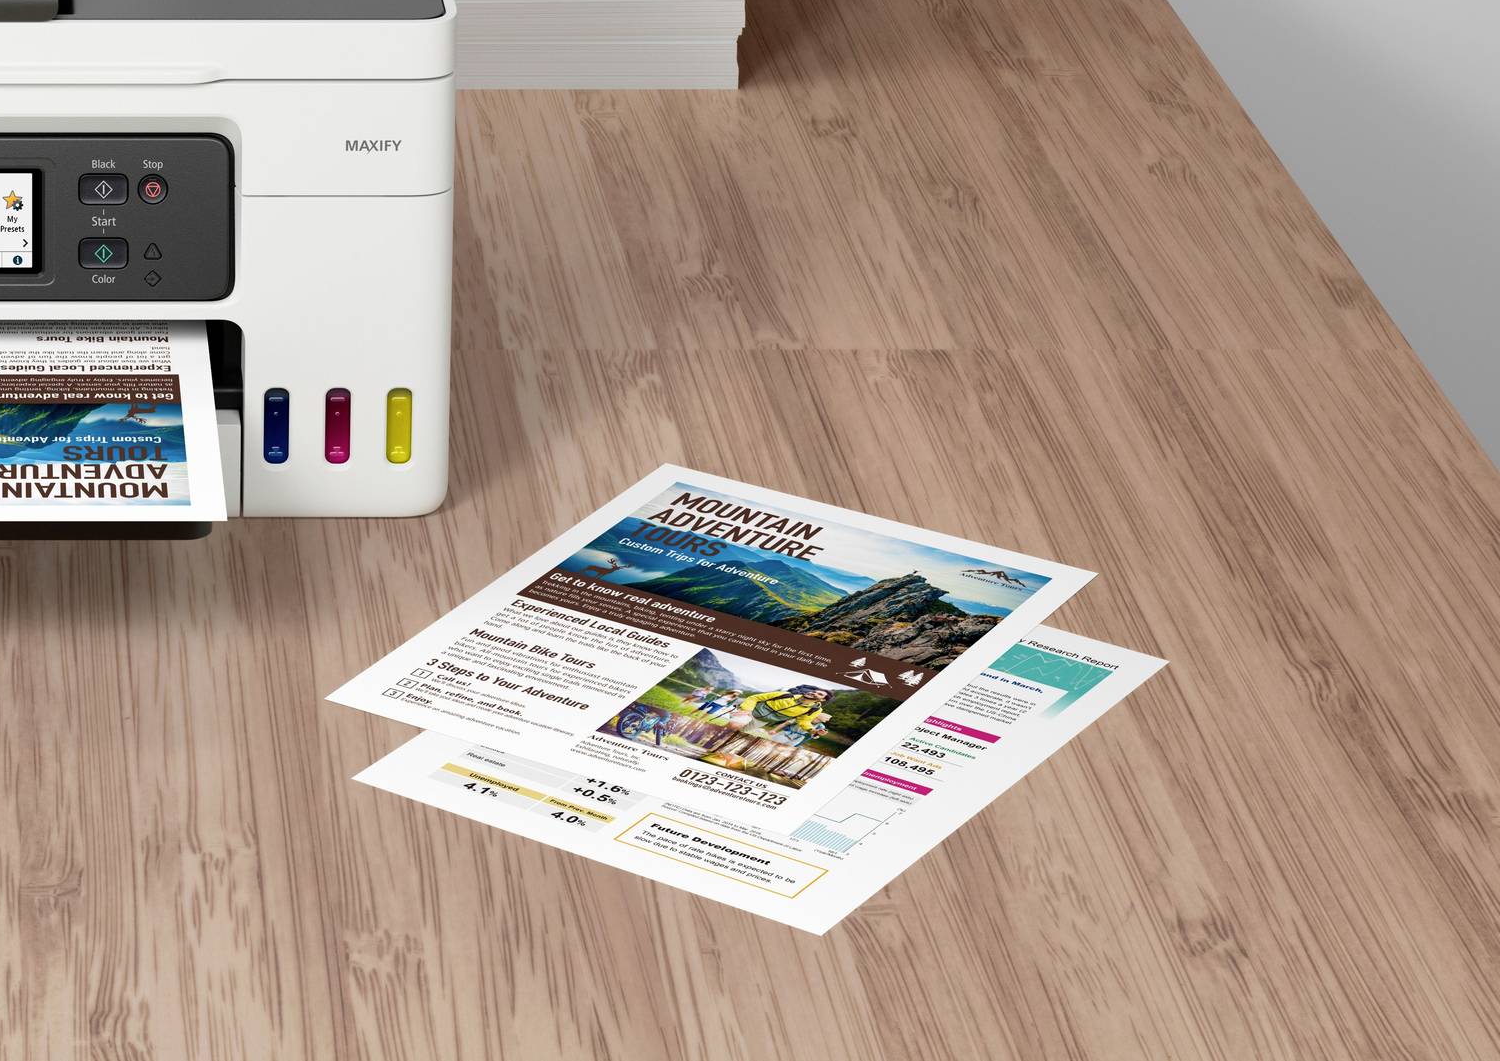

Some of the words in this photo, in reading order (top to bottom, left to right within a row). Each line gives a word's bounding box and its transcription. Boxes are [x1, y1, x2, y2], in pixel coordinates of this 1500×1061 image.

[346, 140, 401, 153] MAXIFY
[91, 159, 116, 169] Black
[143, 160, 163, 170] Stop
[92, 216, 116, 226] Start
[92, 275, 115, 283] Color
[36, 335, 71, 343] Tours
[76, 335, 104, 343] Bike
[89, 363, 171, 372] Experienced
[62, 392, 90, 400] real
[151, 392, 174, 400] Get
[52, 436, 72, 444] for
[75, 434, 108, 444] Trips
[111, 436, 162, 444] Custom
[63, 444, 166, 461] TOURS
[1, 482, 169, 499] MOUNTAIN
[670, 492, 824, 541] MOUNTAIN
[623, 520, 731, 558] TOURS
[646, 508, 824, 563] ADVENTURE
[618, 537, 664, 555] Custom
[665, 549, 696, 563] Trips
[695, 558, 717, 568] for
[715, 563, 780, 585] Adventure
[549, 572, 573, 584] Get
[572, 578, 587, 588] to
[586, 582, 624, 597] know
[623, 593, 653, 605] real
[650, 601, 716, 623] adventure
[510, 598, 591, 626] Experienced
[588, 620, 628, 636] Local
[626, 631, 671, 648] Guides
[468, 628, 528, 650] Mountain
[528, 644, 559, 659] Bike
[560, 652, 596, 669] Tours
[1027, 640, 1080, 659] Research
[1081, 655, 1119, 670] Report
[436, 674, 456, 683] Call
[437, 661, 475, 677] Steps
[475, 672, 490, 682] to
[492, 676, 523, 691] Your
[520, 686, 590, 710] Adventure
[979, 672, 999, 680] and
[1011, 680, 1043, 694] March,
[405, 693, 433, 705] Enjoy.
[419, 683, 442, 694] Plan,
[444, 690, 474, 703] refine,
[476, 700, 497, 709] and
[496, 705, 522, 717] book.
[922, 717, 962, 731] ghlights
[914, 726, 941, 737] oject
[941, 733, 988, 751] Manager
[901, 741, 946, 759] 22,493
[884, 756, 935, 775] 108,495
[468, 772, 520, 792] Unemployed
[715, 771, 755, 785] CONTACT
[463, 782, 498, 797] 4.1%
[586, 778, 630, 796] +1.6%
[678, 768, 788, 806] 0123-123-123
[573, 787, 616, 805] +0.5%
[550, 811, 586, 826] 4.0%
[650, 823, 690, 839] Future
[691, 836, 771, 866] Development
[634, 835, 653, 844] slow
[652, 841, 669, 849] due
[678, 850, 703, 861] stable
[703, 858, 730, 869] wages
[729, 867, 747, 875] and
[745, 872, 772, 883] prices.
[642, 830, 657, 838] The
[656, 836, 678, 845] pace
[688, 846, 705, 854] rate
[705, 851, 727, 862] hikes
[737, 862, 775, 877] expected
